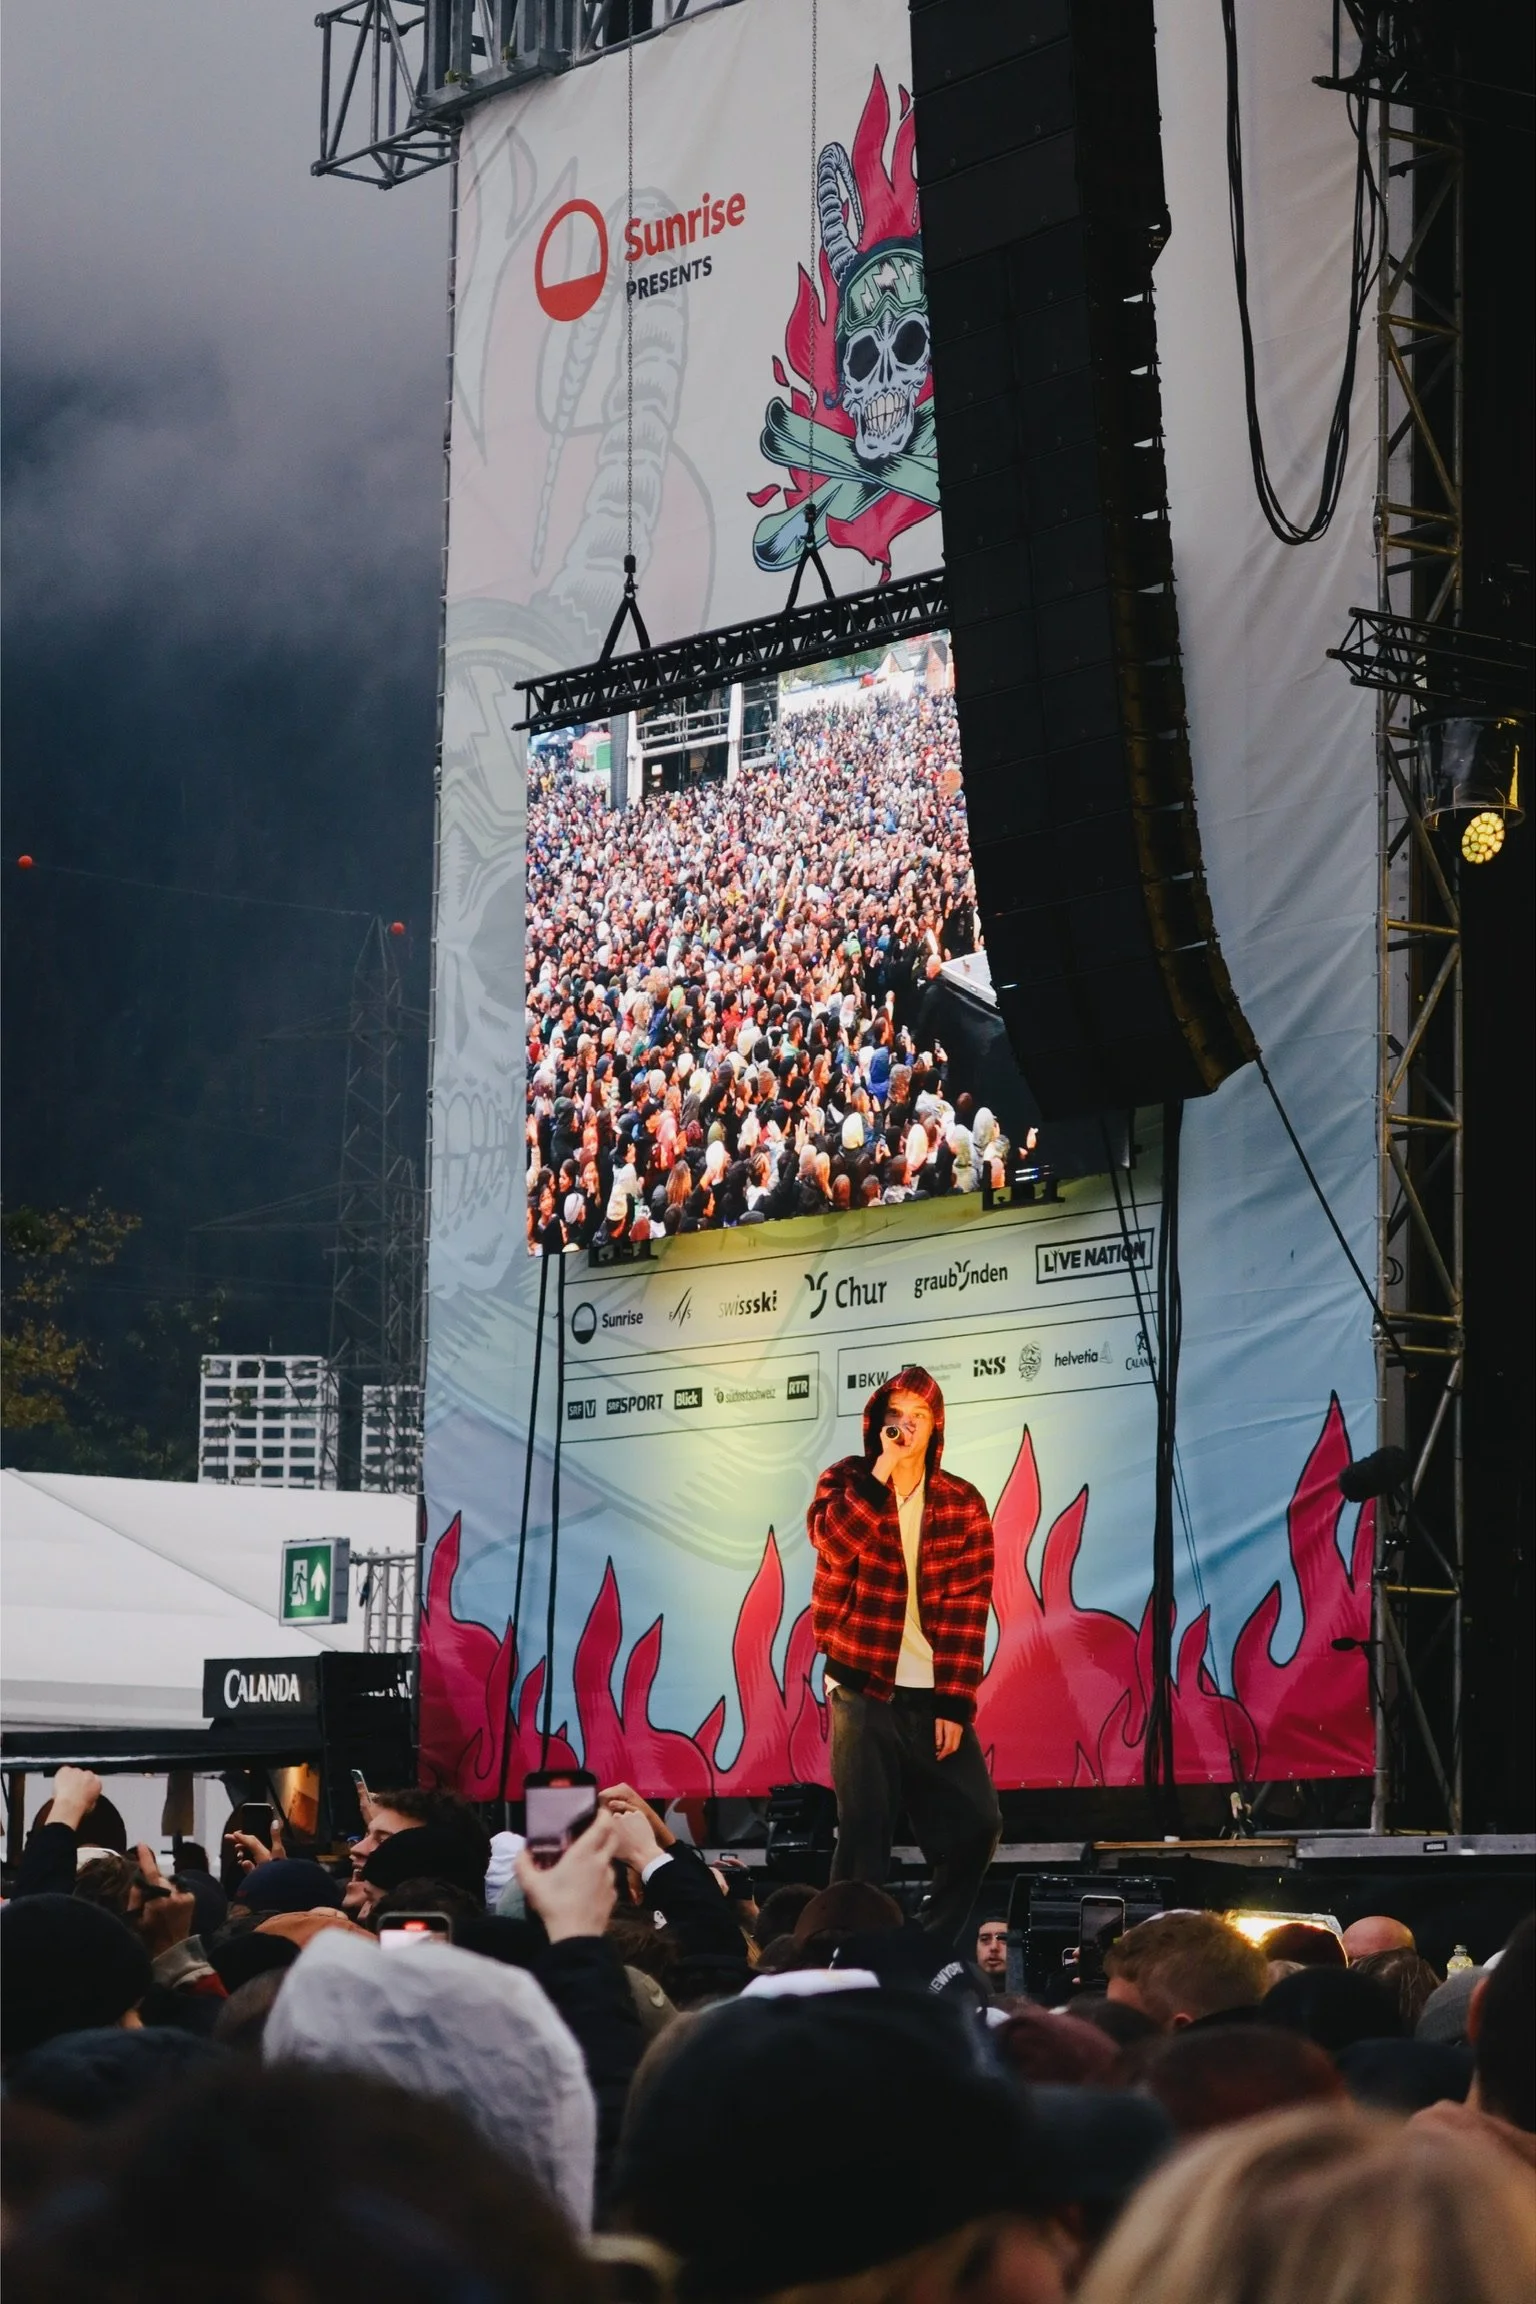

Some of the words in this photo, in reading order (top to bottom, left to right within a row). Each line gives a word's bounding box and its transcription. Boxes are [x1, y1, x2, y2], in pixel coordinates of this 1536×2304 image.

[624, 192, 746, 261] Sunrise
[626, 256, 712, 302] PRESENTS
[1044, 1249, 1082, 1273] LIVE
[1084, 1241, 1146, 1267] NATION
[835, 1276, 887, 1308] Chur
[602, 1310, 644, 1328] Sunrise
[1054, 1349, 1098, 1367] helvetia
[788, 1380, 808, 1395] RTR
[859, 1371, 889, 1388] BKW
[676, 1391, 698, 1406] Blick
[223, 1668, 301, 1709] CALANDA
